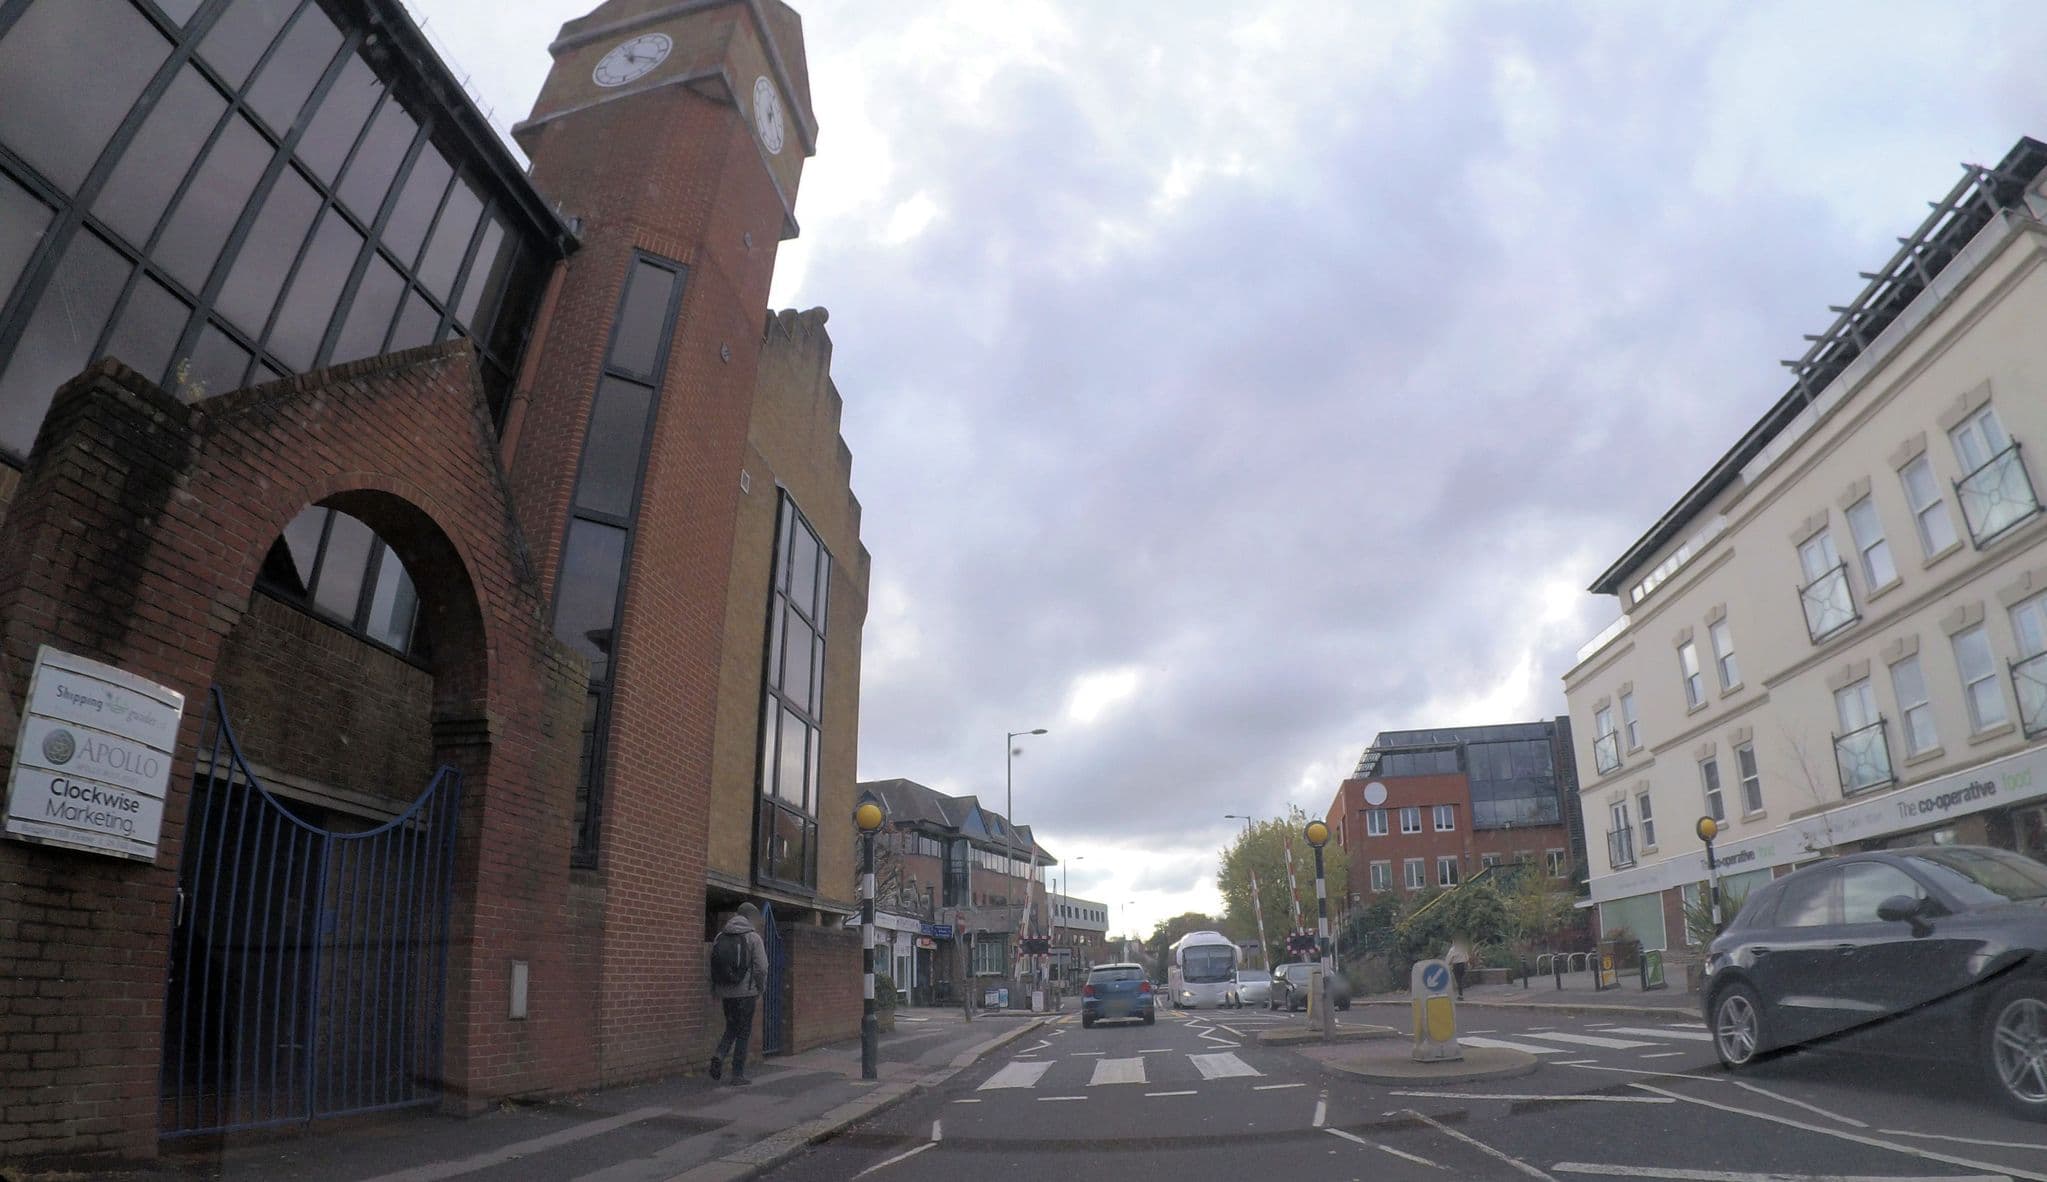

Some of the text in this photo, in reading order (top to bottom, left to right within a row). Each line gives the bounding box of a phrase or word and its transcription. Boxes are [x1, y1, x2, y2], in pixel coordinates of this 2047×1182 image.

[56, 684, 103, 712] Shipping
[77, 738, 159, 779] APOLLO
[51, 778, 140, 813] Clockwise
[1897, 801, 1917, 818] The
[1919, 780, 1997, 812] co-operative
